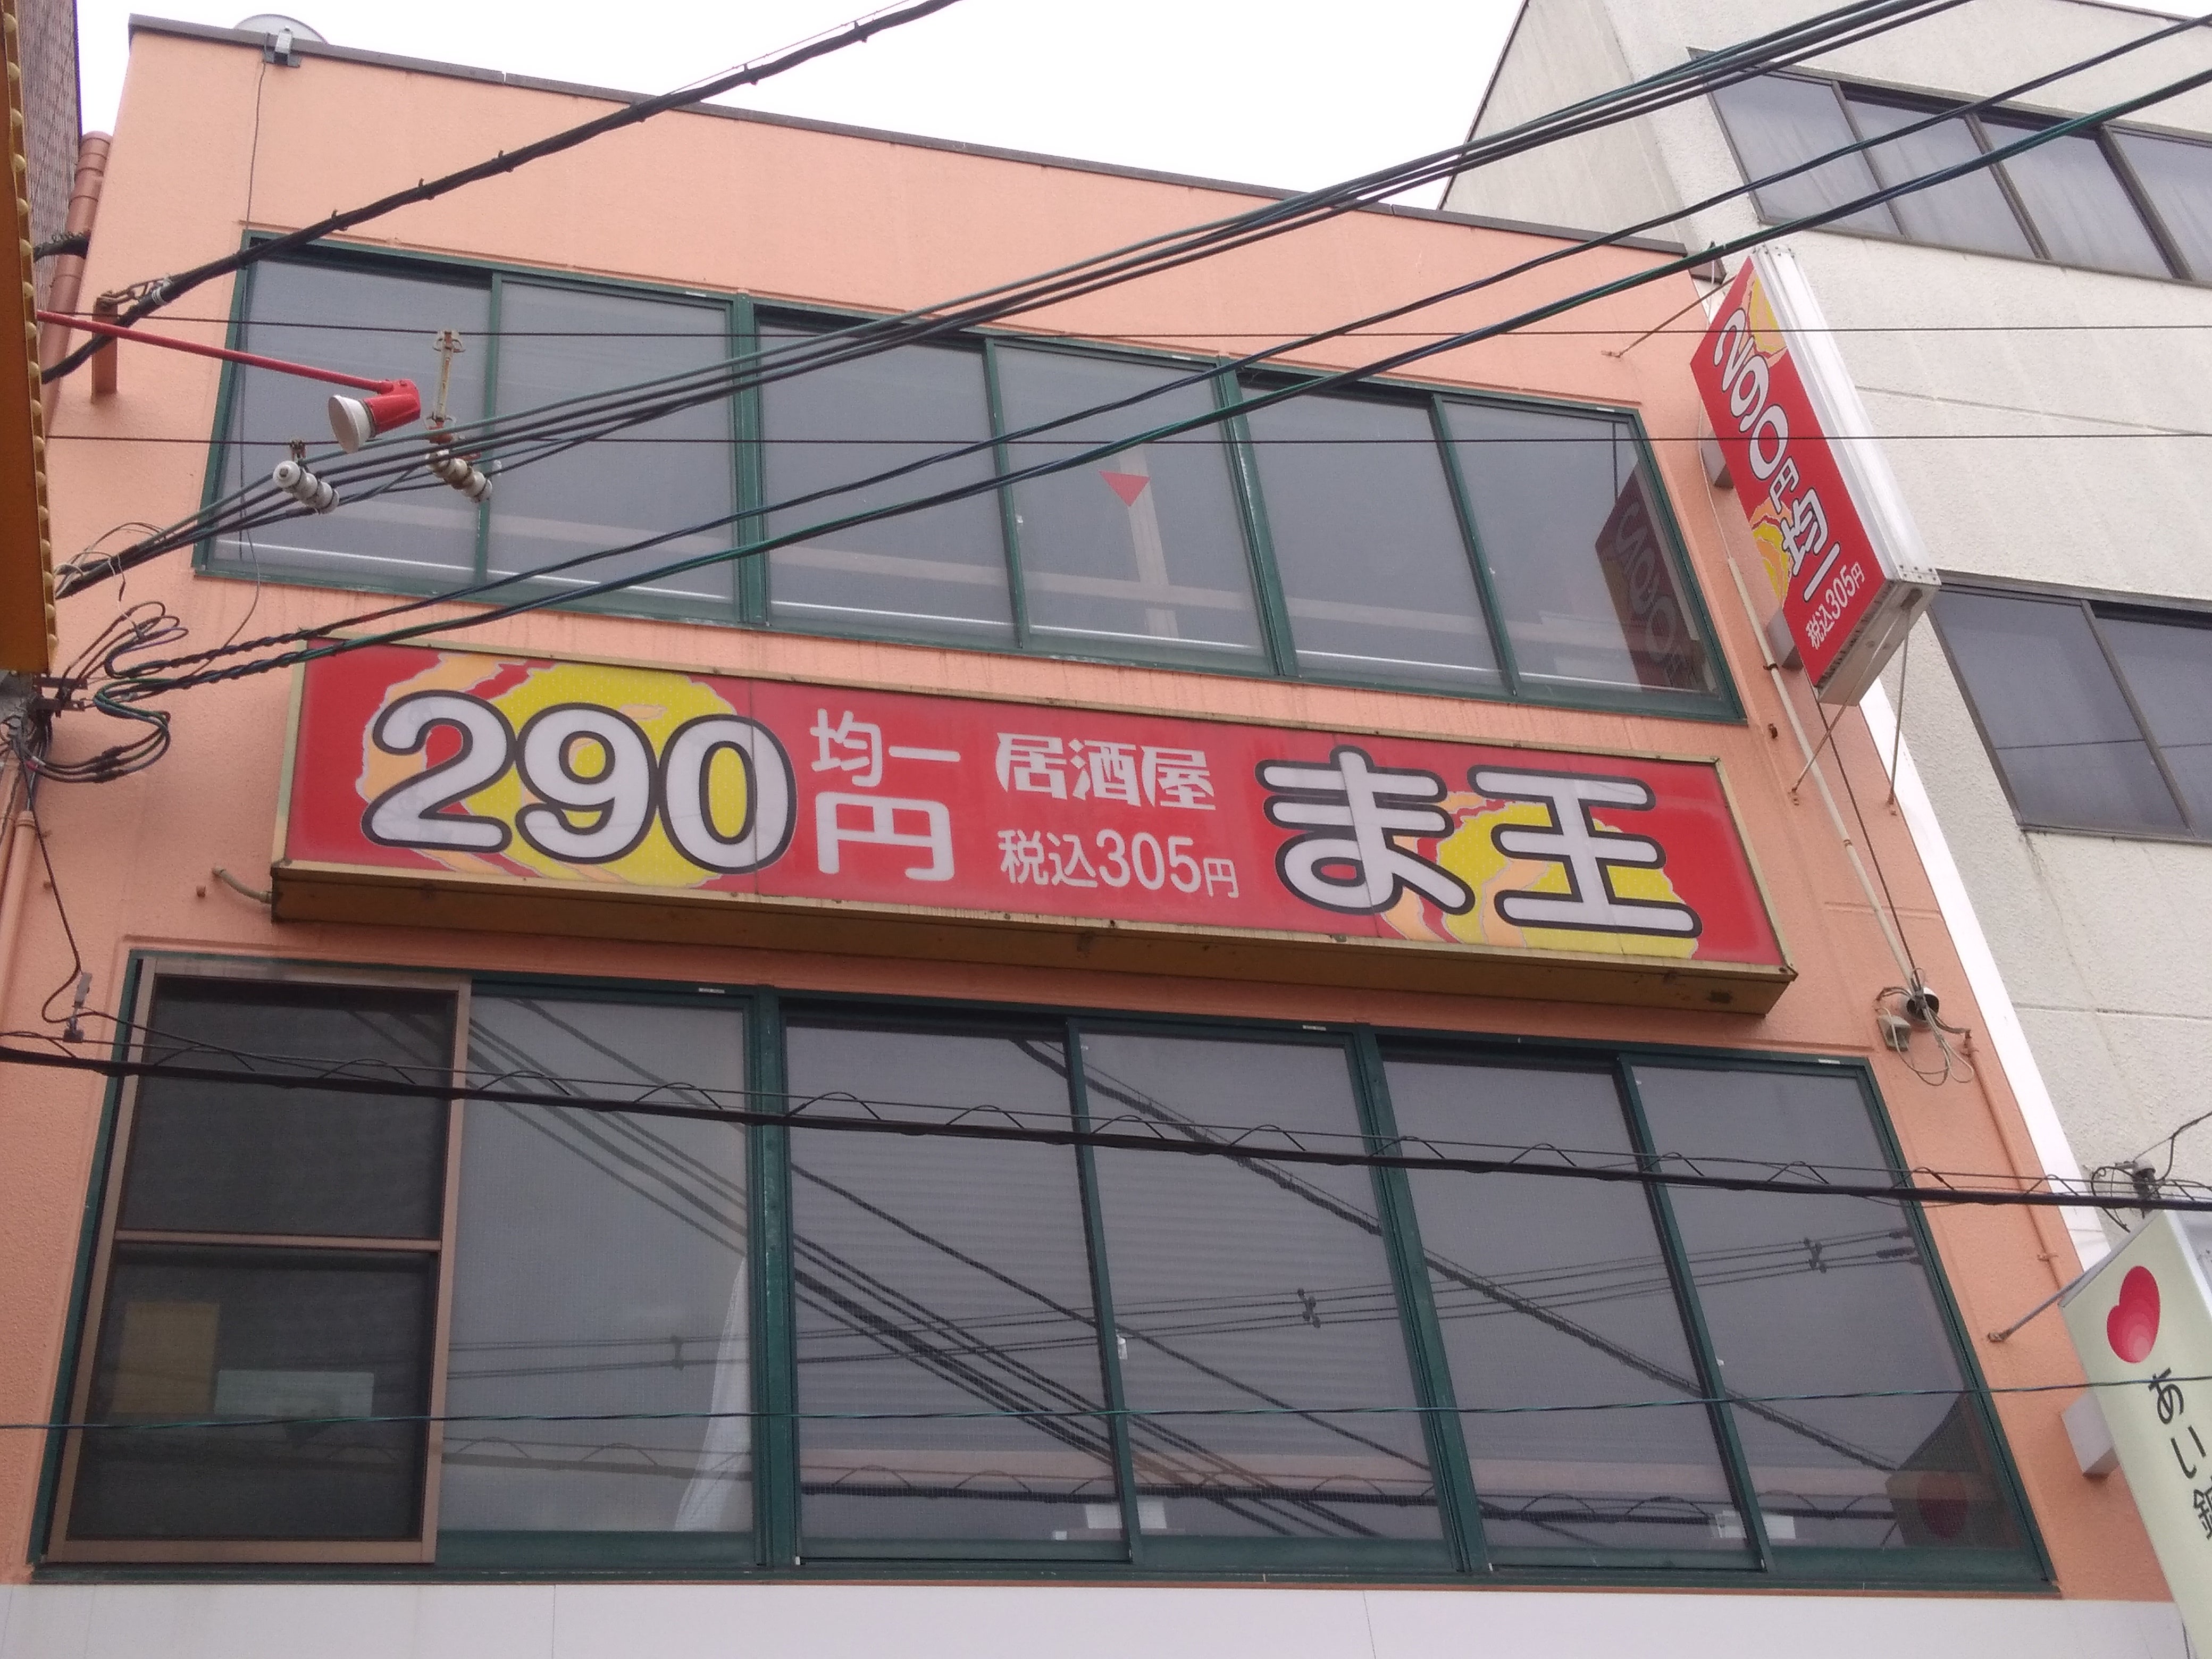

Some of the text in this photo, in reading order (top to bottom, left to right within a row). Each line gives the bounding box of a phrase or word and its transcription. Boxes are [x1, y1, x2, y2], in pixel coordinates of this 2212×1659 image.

[1805, 562, 1865, 650] 税込305円
[996, 732, 1216, 810] 居酒屋
[998, 828, 1240, 899] 税込305円
[1255, 745, 1702, 937] ま王
